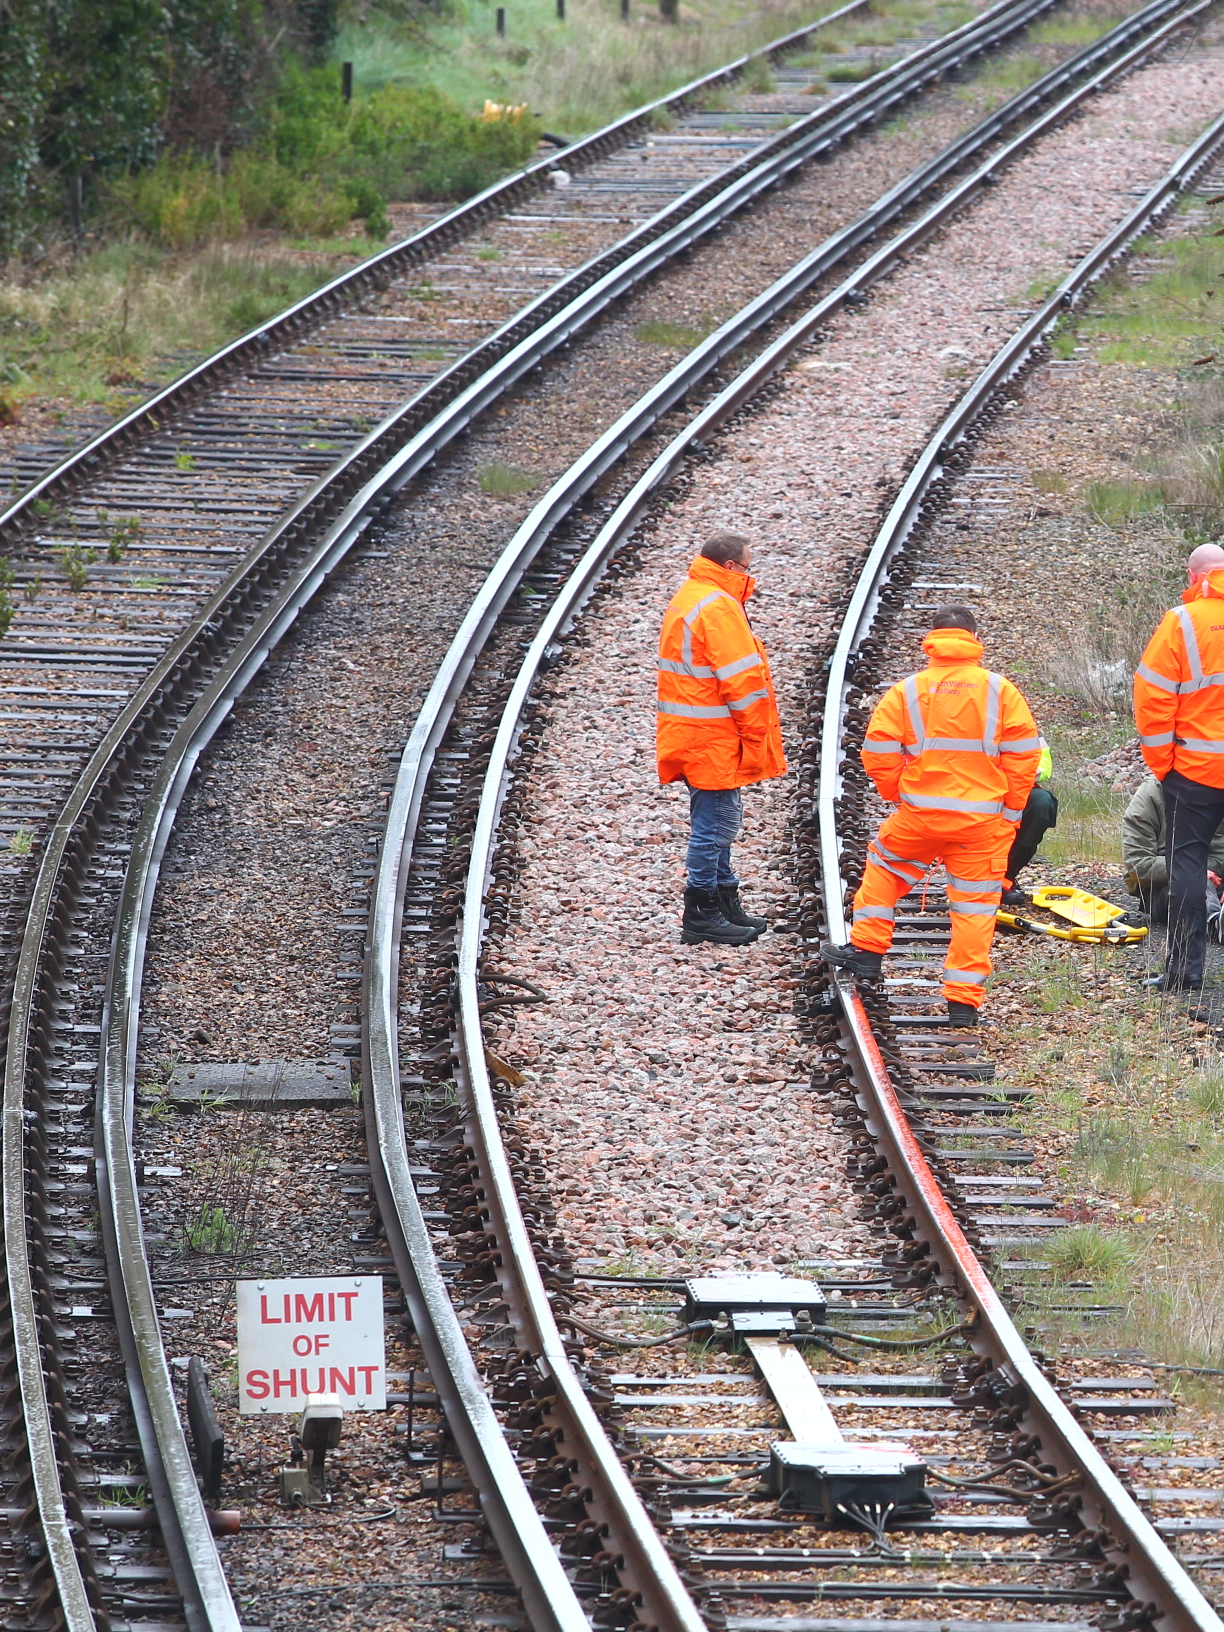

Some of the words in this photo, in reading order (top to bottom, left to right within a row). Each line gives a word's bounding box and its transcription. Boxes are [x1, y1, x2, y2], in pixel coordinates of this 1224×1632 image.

[936, 687, 960, 696] Railway
[950, 681, 977, 689] Western
[260, 1292, 359, 1325] LIMIT
[292, 1334, 330, 1357] OF
[245, 1365, 380, 1400] SHUNT
